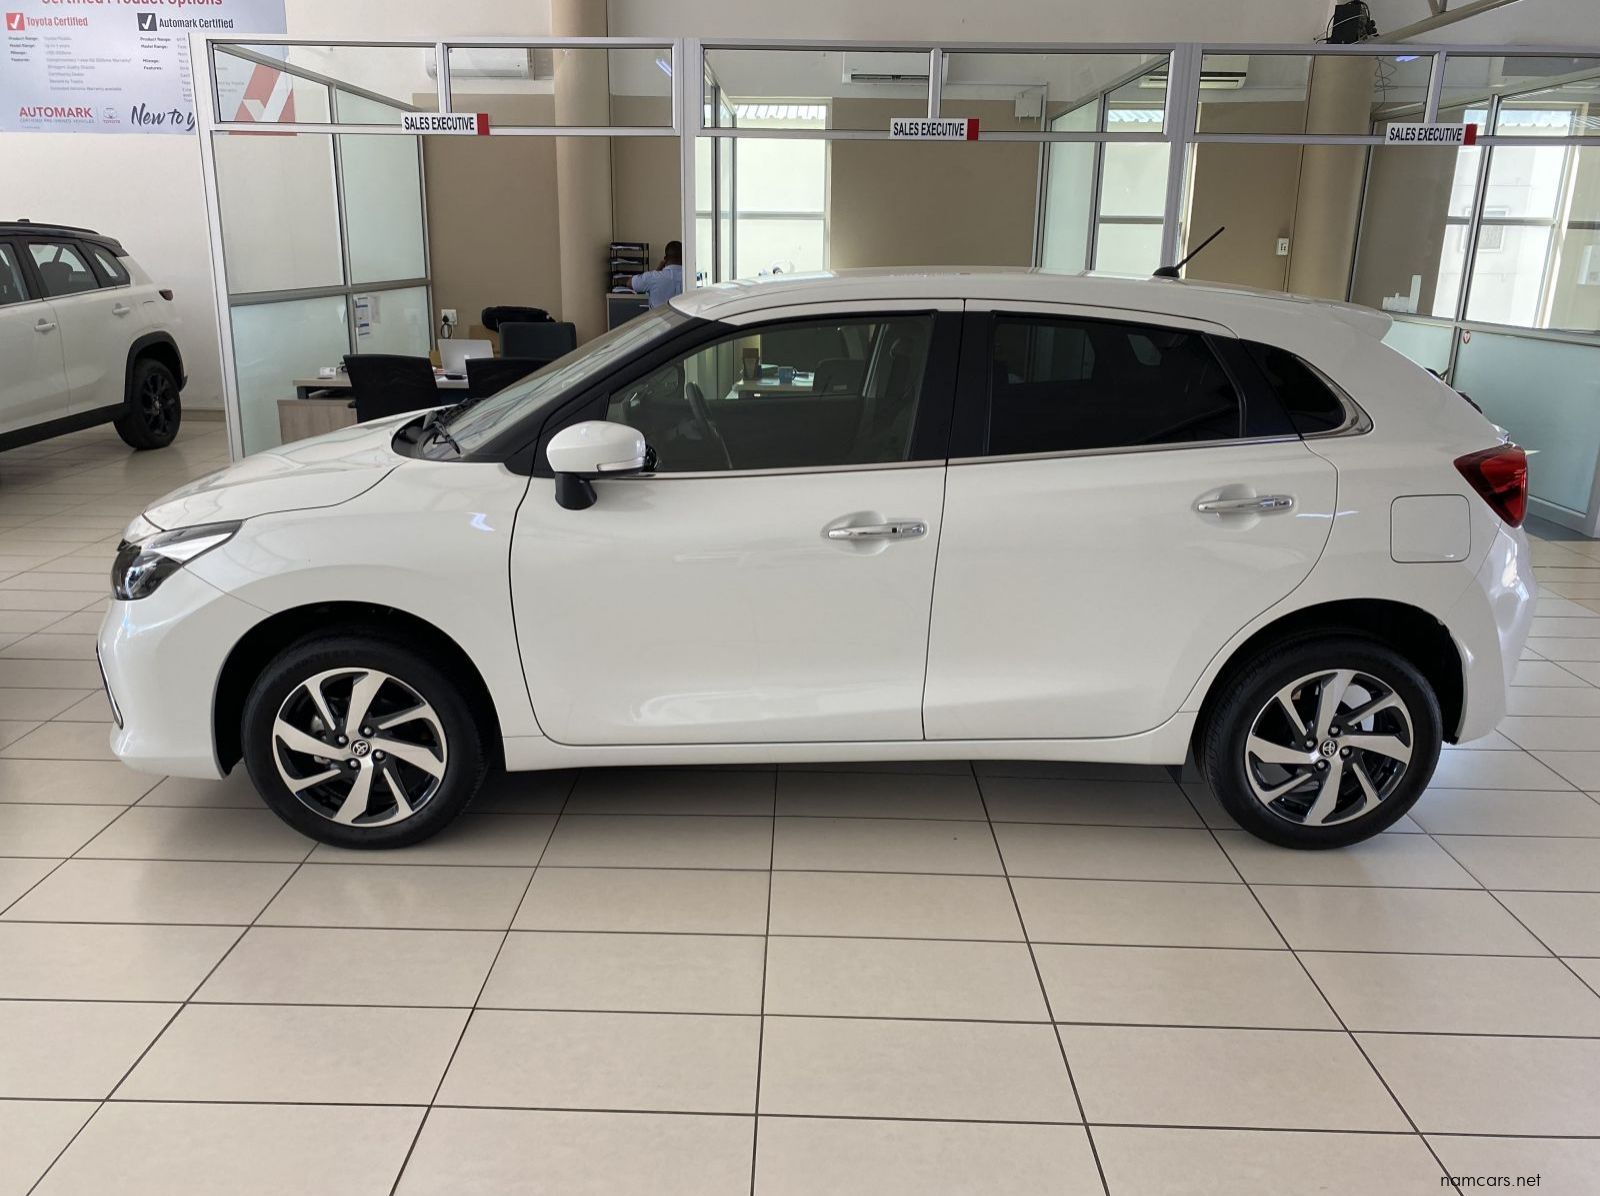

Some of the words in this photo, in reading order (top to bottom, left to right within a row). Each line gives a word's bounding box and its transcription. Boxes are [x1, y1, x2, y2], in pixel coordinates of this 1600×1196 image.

[27, 17, 52, 27] Toyota
[54, 17, 88, 27] Certified
[159, 18, 198, 28] Automark
[199, 19, 234, 29] Certified
[19, 106, 93, 118] AUTOMARK
[131, 102, 165, 126] New
[167, 108, 184, 126] to
[404, 116, 430, 130] SALES
[431, 116, 475, 131] EXECUTIVE
[893, 122, 919, 136] SALES
[921, 122, 965, 137] EXECUTIVE
[1389, 127, 1416, 141] SALES
[1417, 127, 1463, 142] EXECUTIVE
